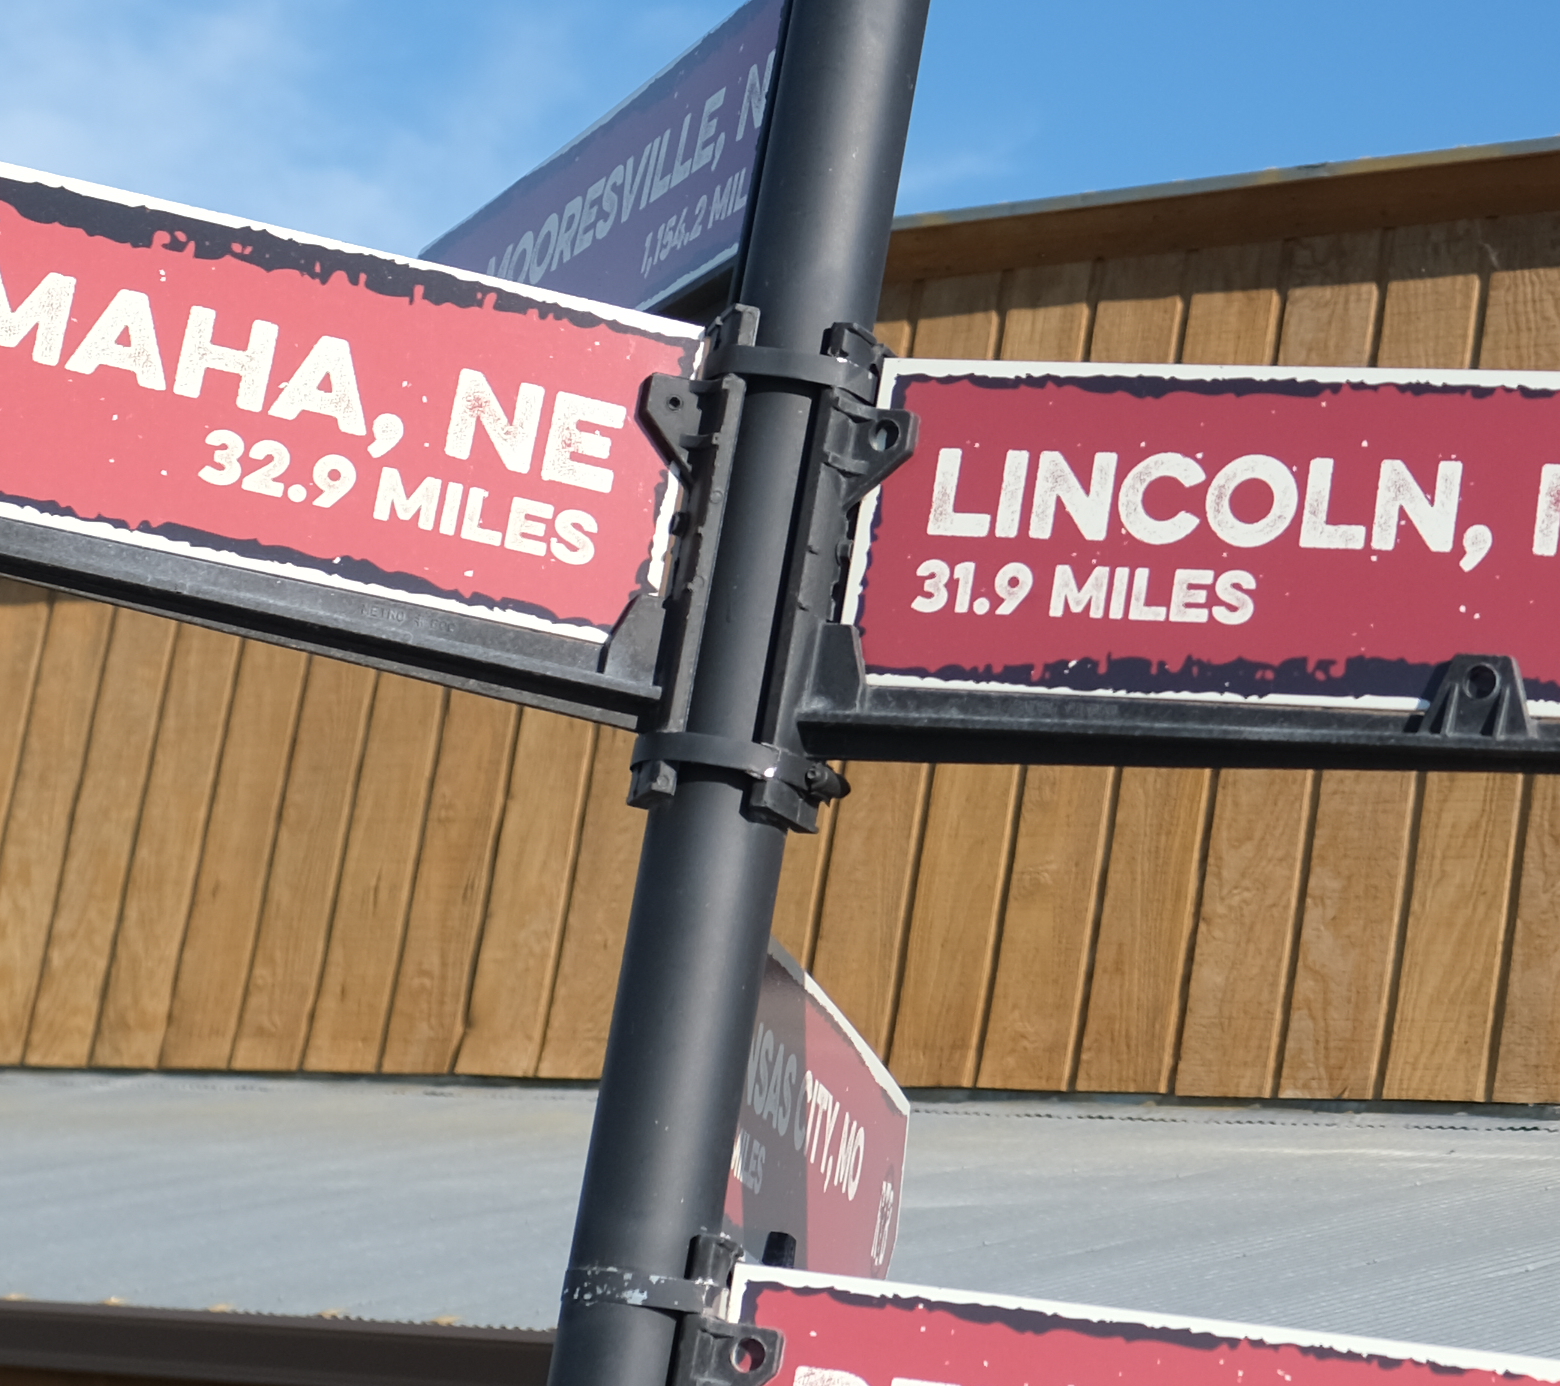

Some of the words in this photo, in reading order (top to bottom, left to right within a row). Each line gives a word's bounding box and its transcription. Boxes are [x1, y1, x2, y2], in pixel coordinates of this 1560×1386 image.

[736, 49, 776, 142] N
[707, 167, 748, 230] MIL
[445, 367, 627, 494] NE
[197, 429, 357, 509] 32.9
[372, 466, 599, 566] MILES
[926, 447, 1494, 574] LINCOLN,
[910, 559, 1034, 615] 31.9
[1048, 564, 1258, 626] MILES
[793, 1070, 840, 1193] CITY,
[833, 1111, 865, 1201] MO
